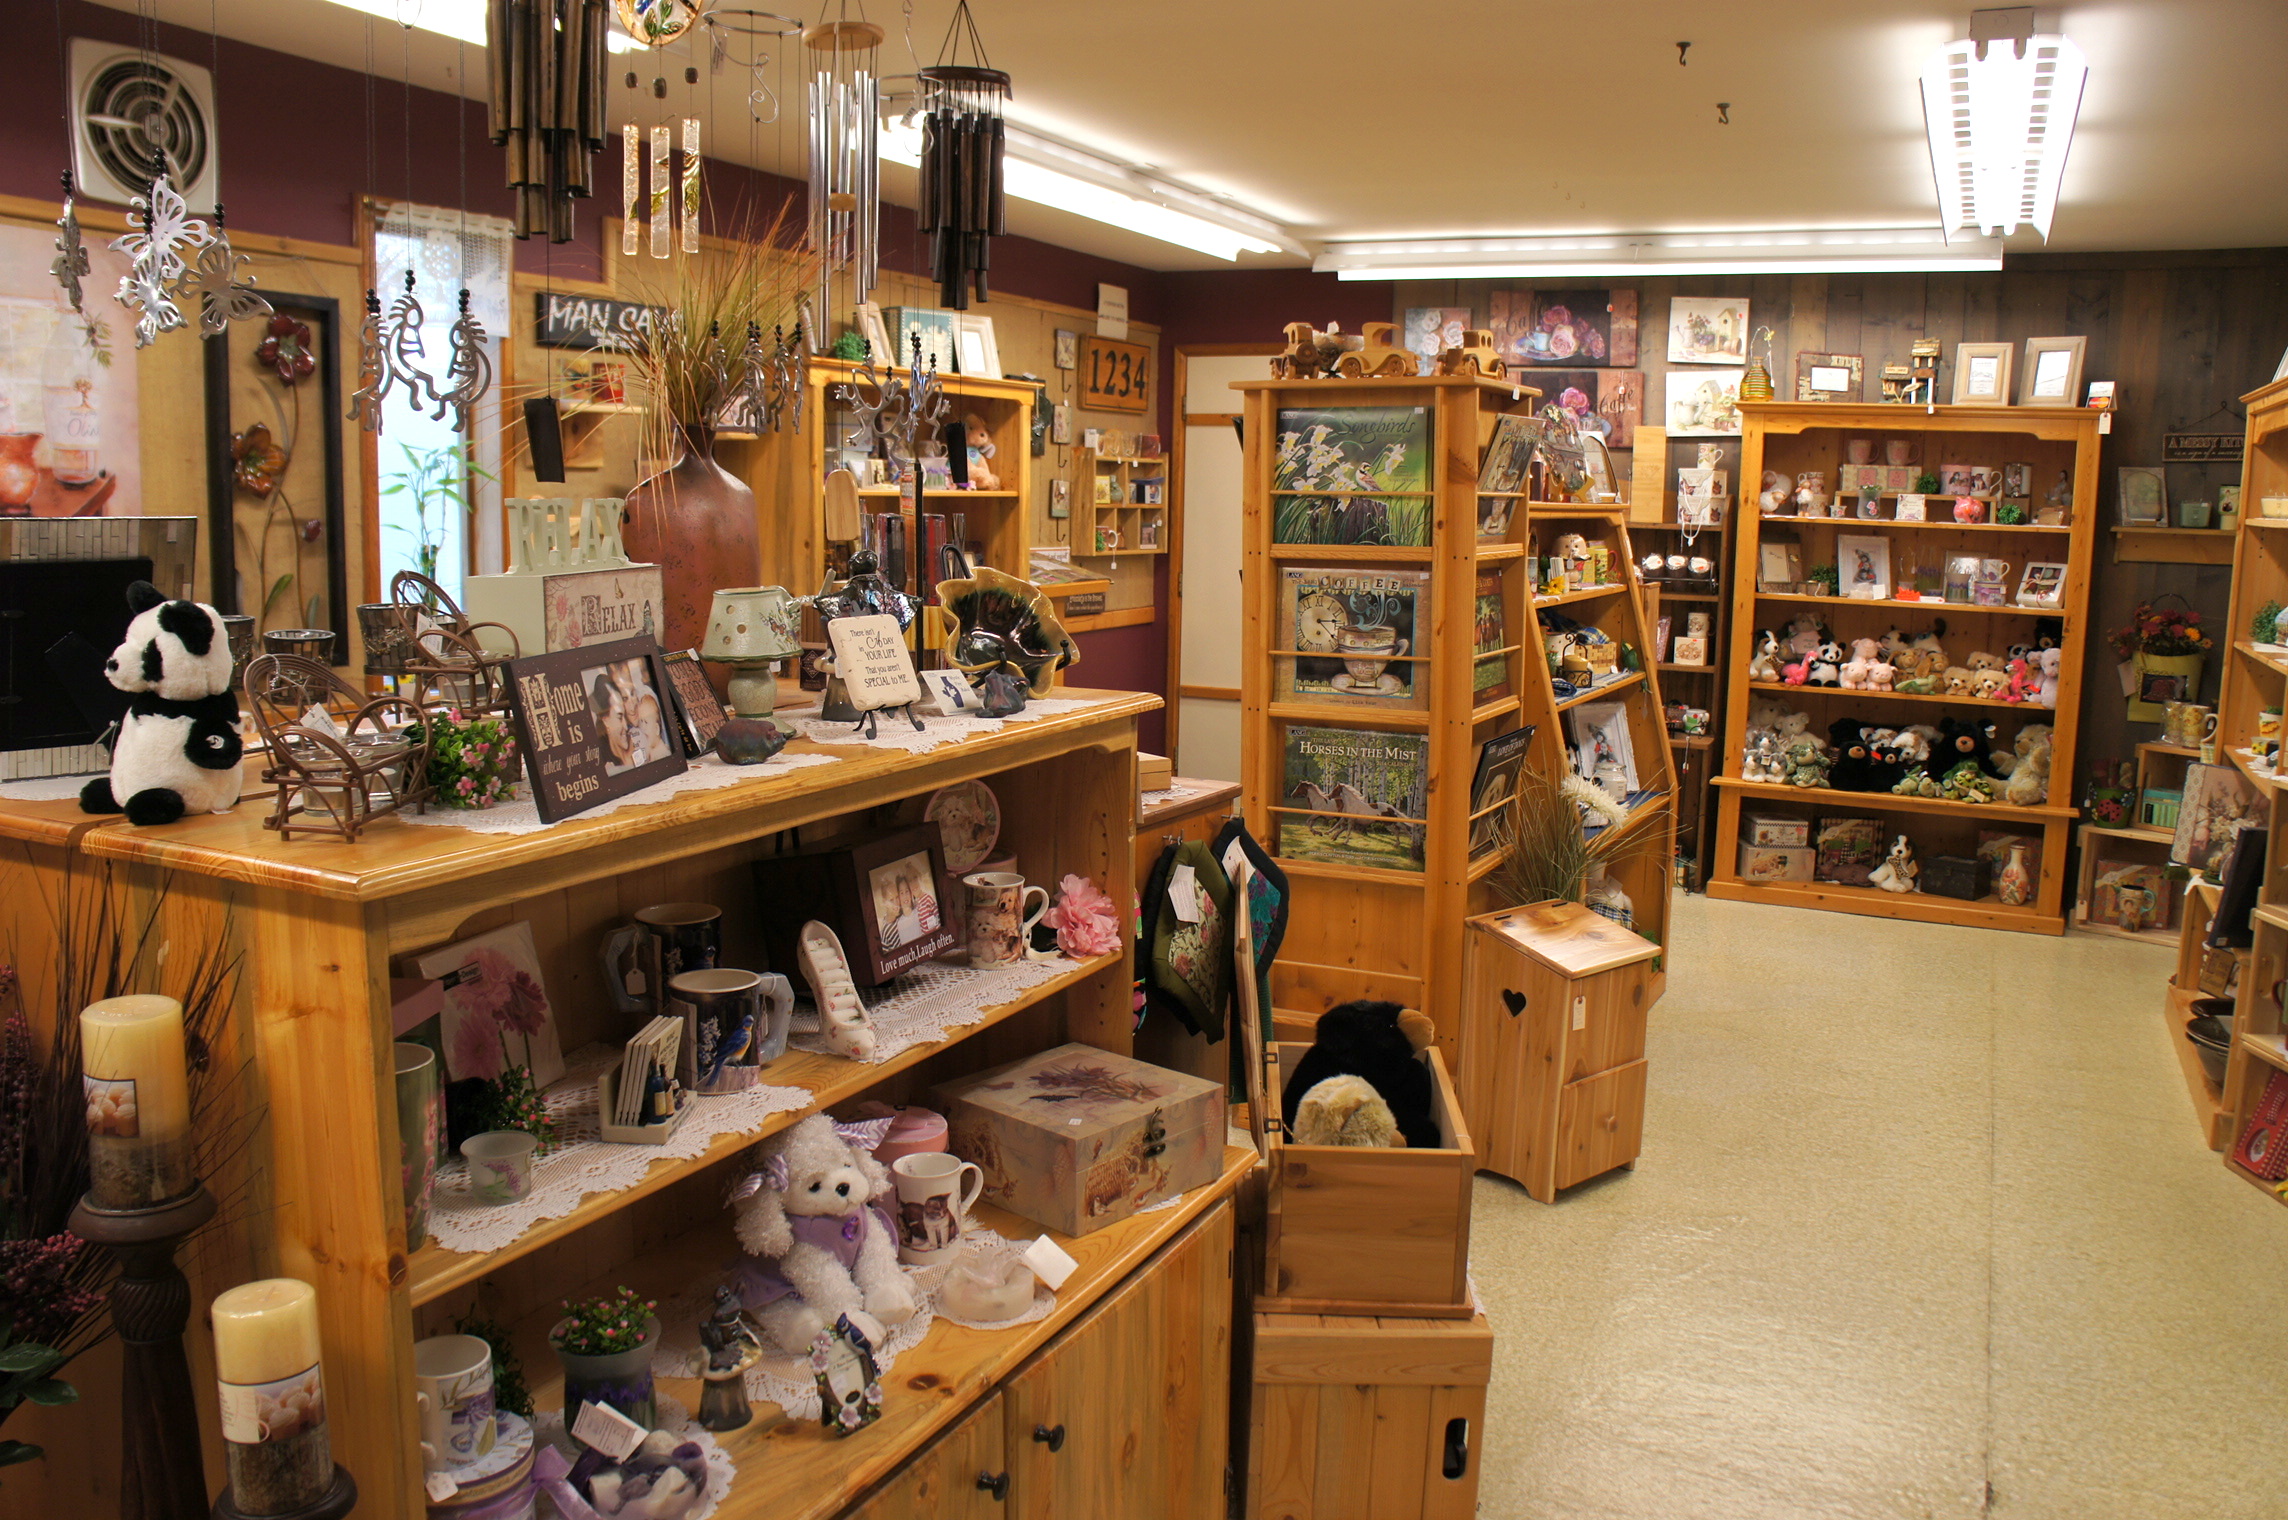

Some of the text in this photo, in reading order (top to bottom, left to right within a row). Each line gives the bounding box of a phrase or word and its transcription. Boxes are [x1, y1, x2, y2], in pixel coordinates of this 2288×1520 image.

[548, 295, 611, 333] MAN
[1089, 348, 1146, 399] 1234
[1341, 413, 1416, 444] Songbirds
[505, 498, 628, 571] RELAX
[1319, 574, 1402, 591] COFFEE
[581, 595, 637, 638] RELAX
[865, 650, 885, 661] YOUR
[883, 648, 897, 658] LIFE
[883, 637, 895, 645] DAY
[864, 675, 891, 688] SPECIAL
[890, 676, 898, 685] to
[865, 666, 878, 675] That
[877, 666, 887, 676] you
[519, 672, 585, 752] Home
[568, 718, 584, 745] is
[1300, 741, 1417, 761] HORSES IN THE MIST
[556, 773, 600, 802] begins
[880, 959, 898, 975] Love
[936, 933, 955, 949] often.
